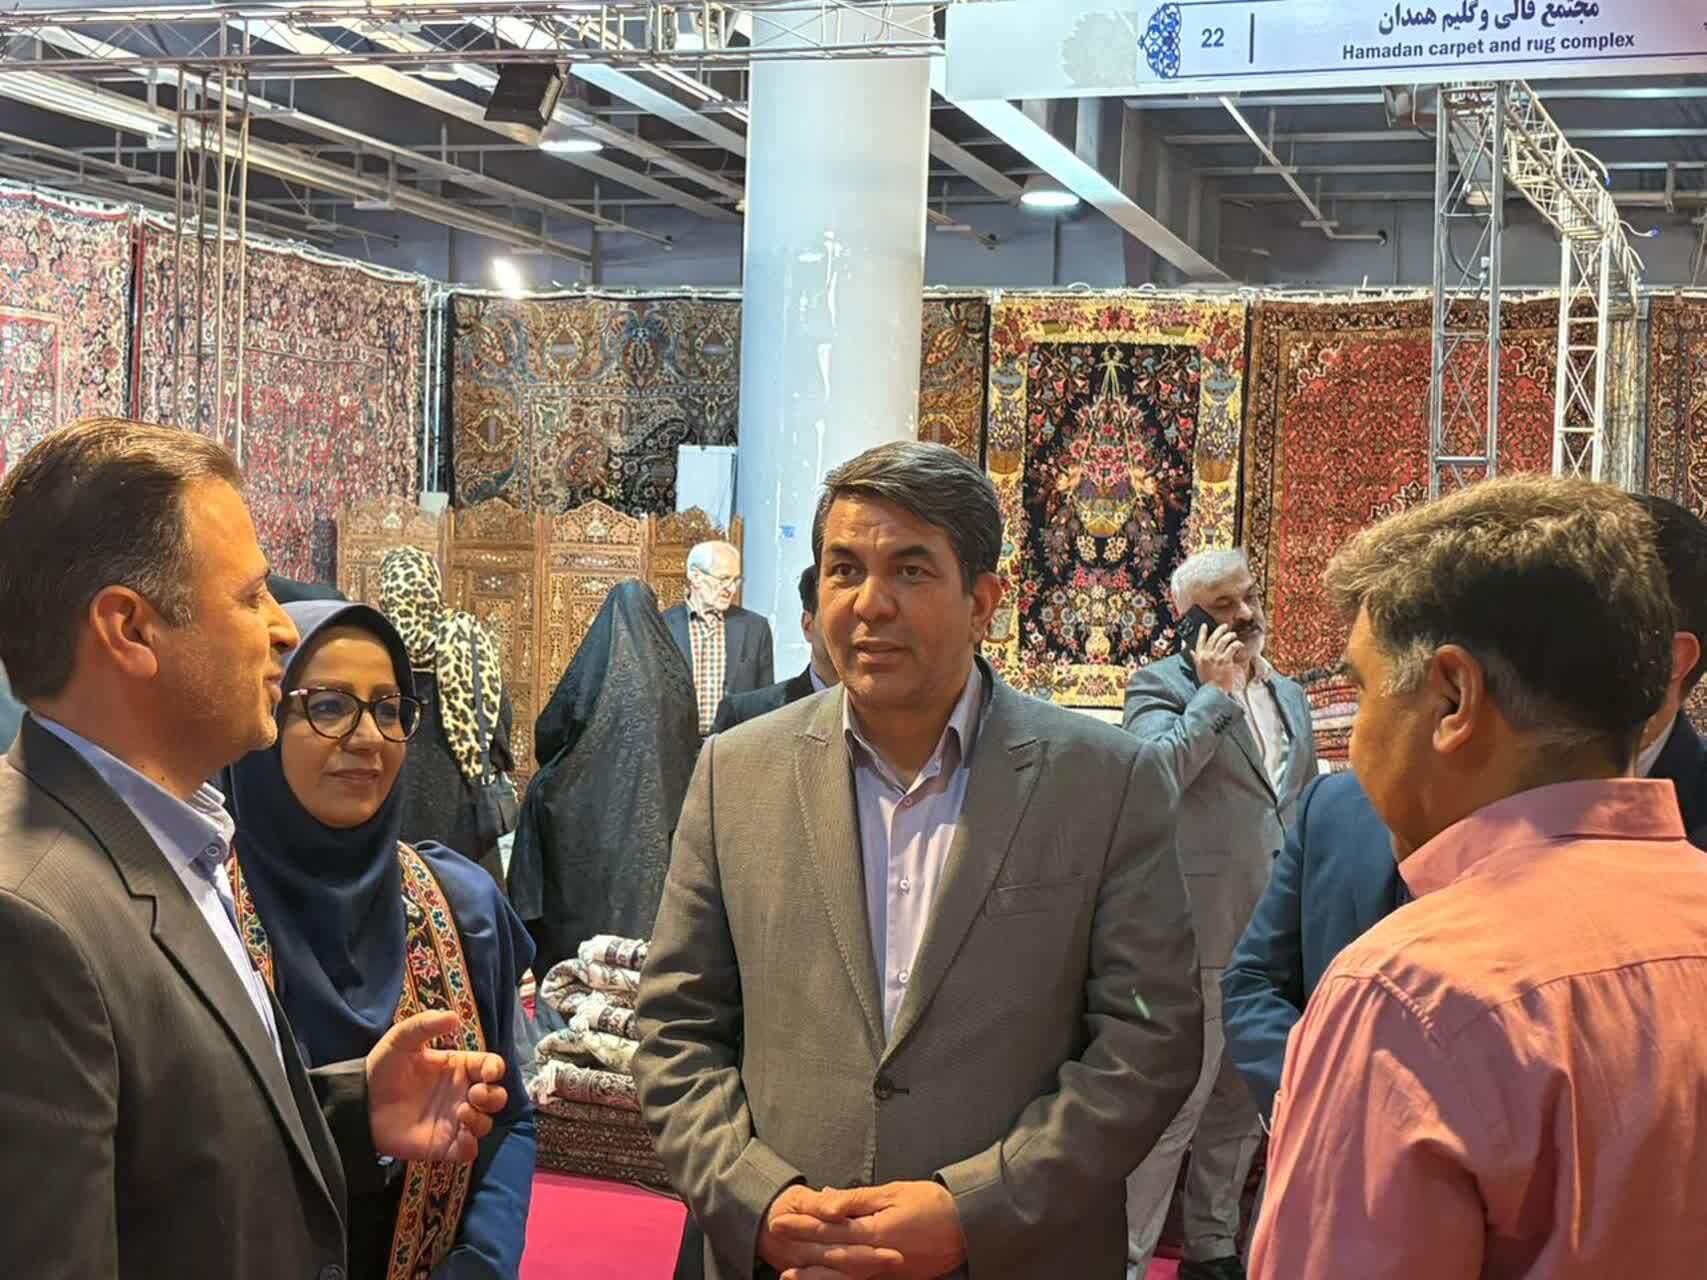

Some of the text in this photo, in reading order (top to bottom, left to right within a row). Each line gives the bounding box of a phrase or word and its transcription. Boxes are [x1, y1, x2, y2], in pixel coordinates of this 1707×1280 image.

[1378, 2, 1437, 35] همدان
[1541, 0, 1599, 27] مجتمع
[1200, 27, 1225, 48] 22
[1342, 32, 1635, 60] Hamadan carpet and rug complex
